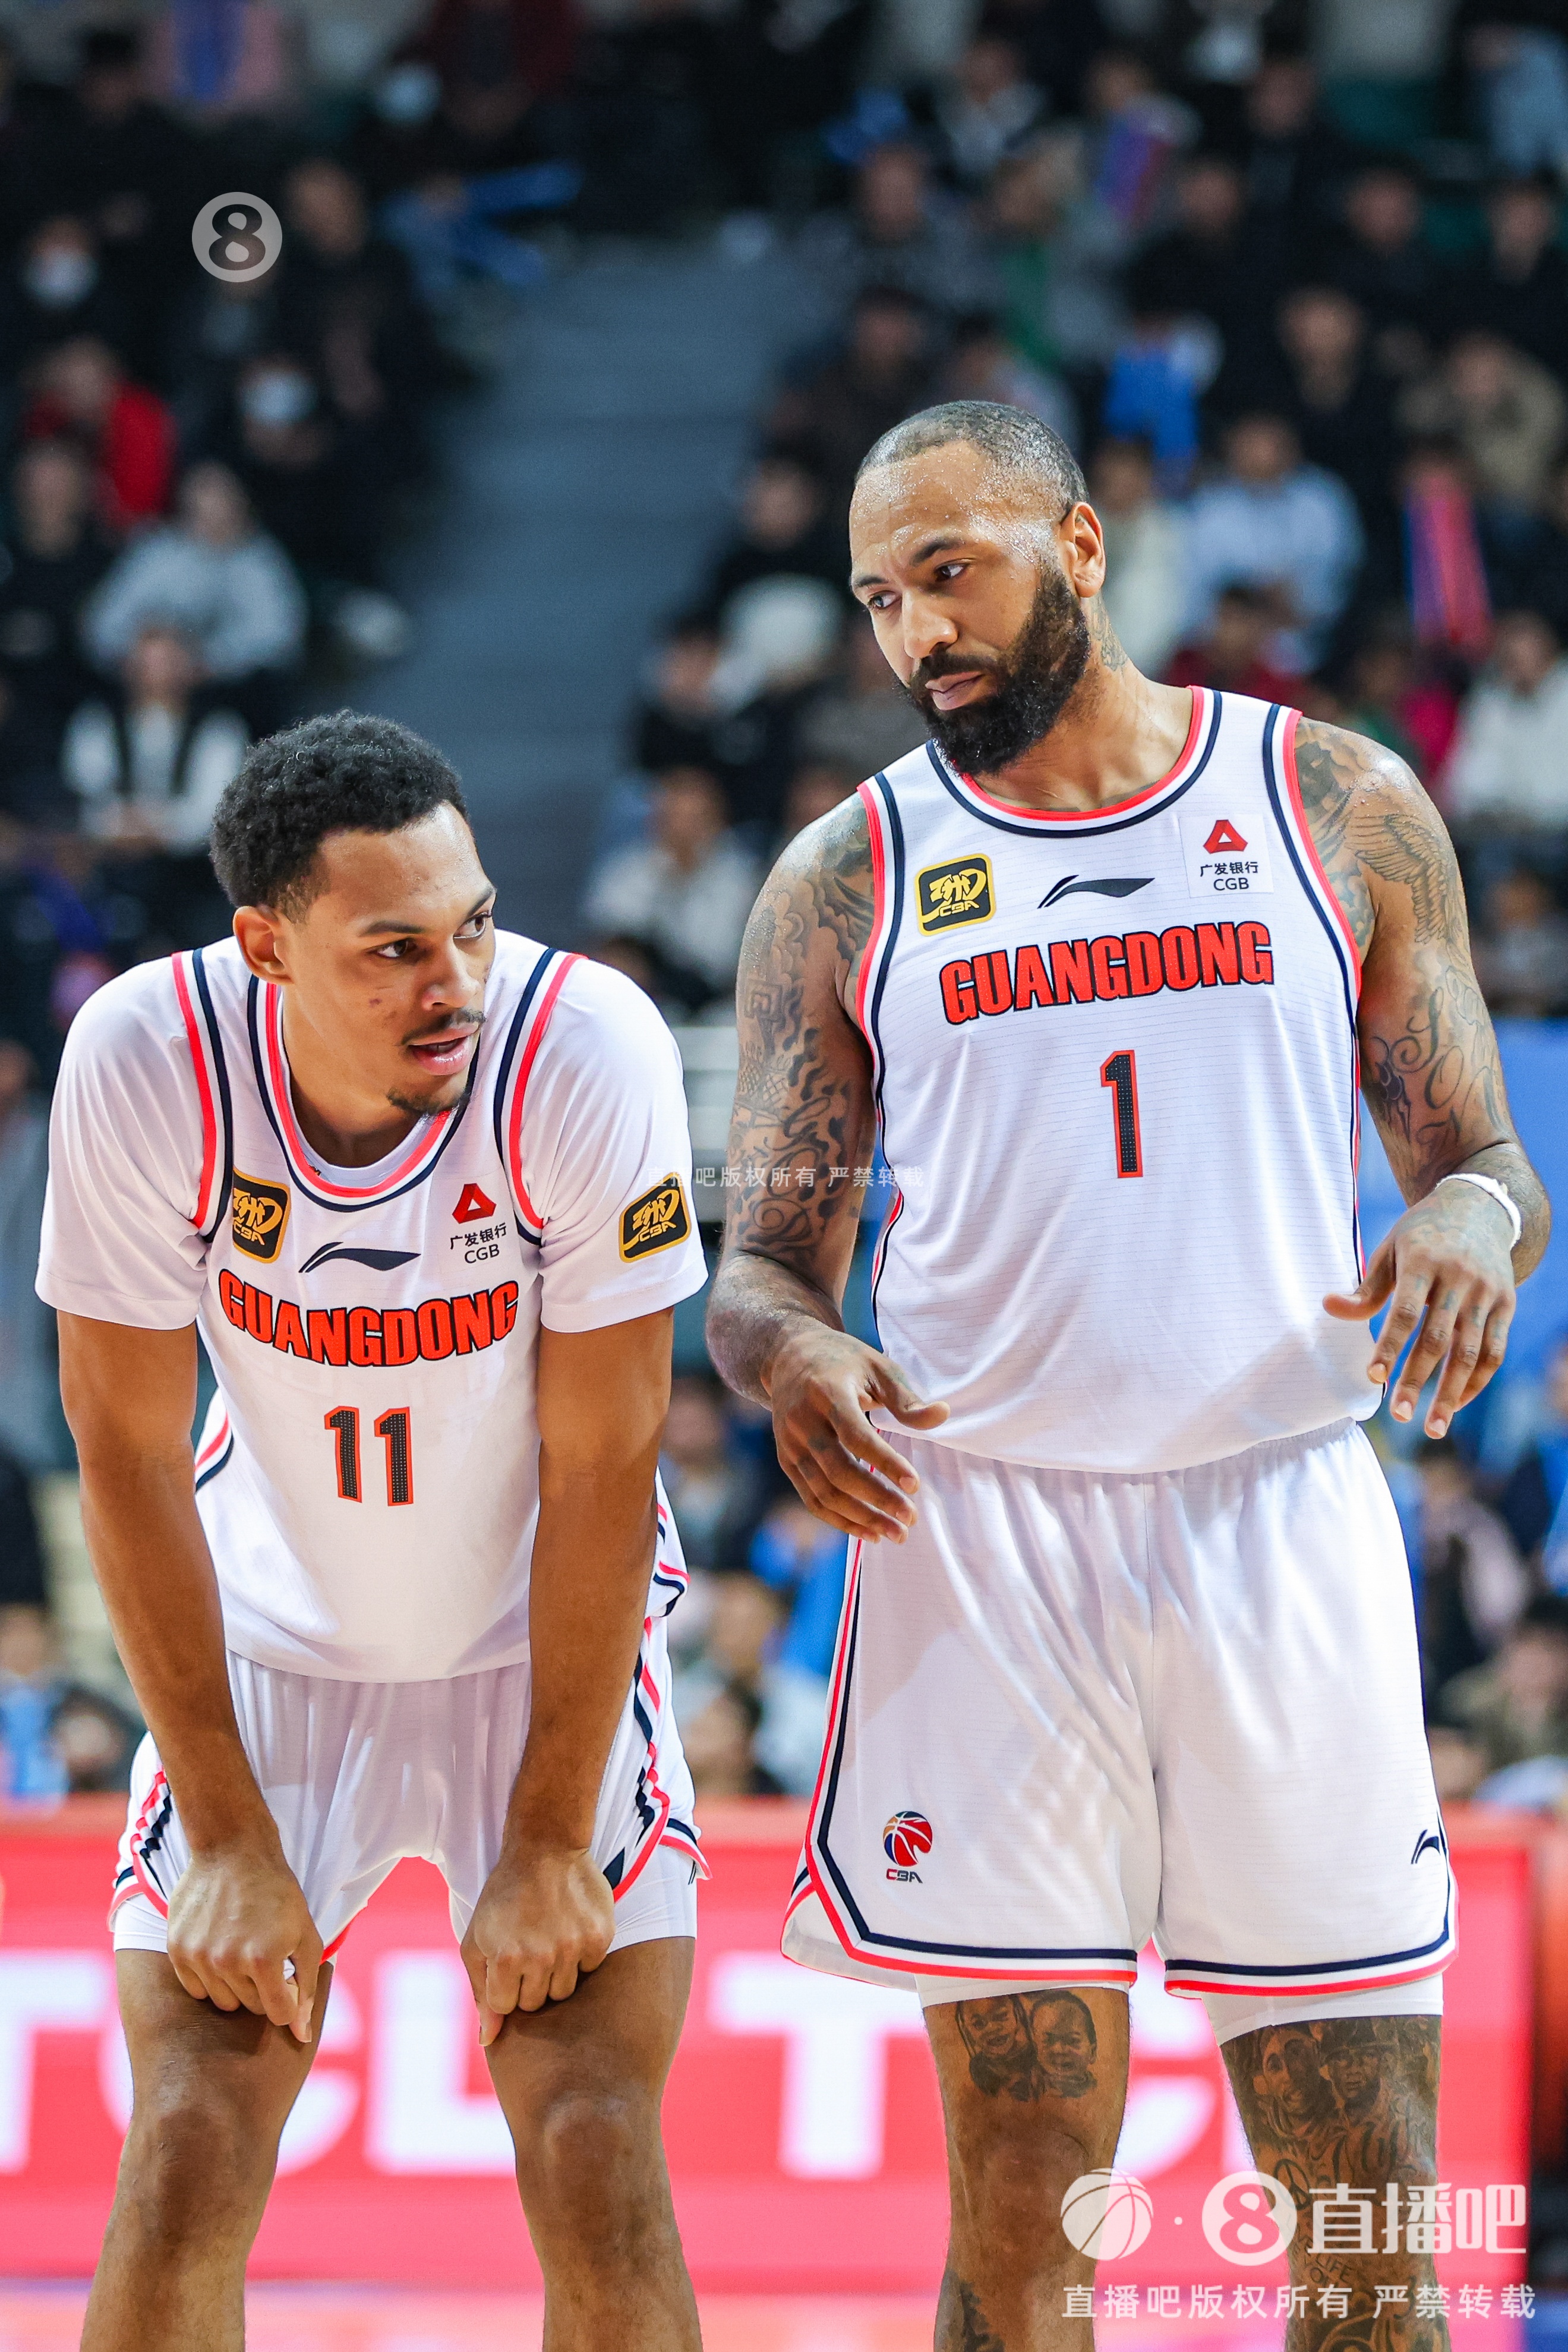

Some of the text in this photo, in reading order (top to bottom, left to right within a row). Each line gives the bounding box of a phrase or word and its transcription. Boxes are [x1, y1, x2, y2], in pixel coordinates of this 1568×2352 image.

[1200, 861, 1258, 877] 广发银行
[1213, 877, 1250, 892] CGB
[939, 899, 980, 917] CBA
[939, 921, 1274, 1025] GUANGDONG
[1100, 1049, 1143, 1178] 1
[234, 1220, 266, 1246] CBA
[449, 1222, 508, 1250] 广发银行
[639, 1221, 677, 1242] CBA
[464, 1244, 500, 1264] CGB
[219, 1268, 519, 1367] GUANGDONG
[324, 1405, 414, 1506] 11
[886, 1868, 923, 1884] CBA
